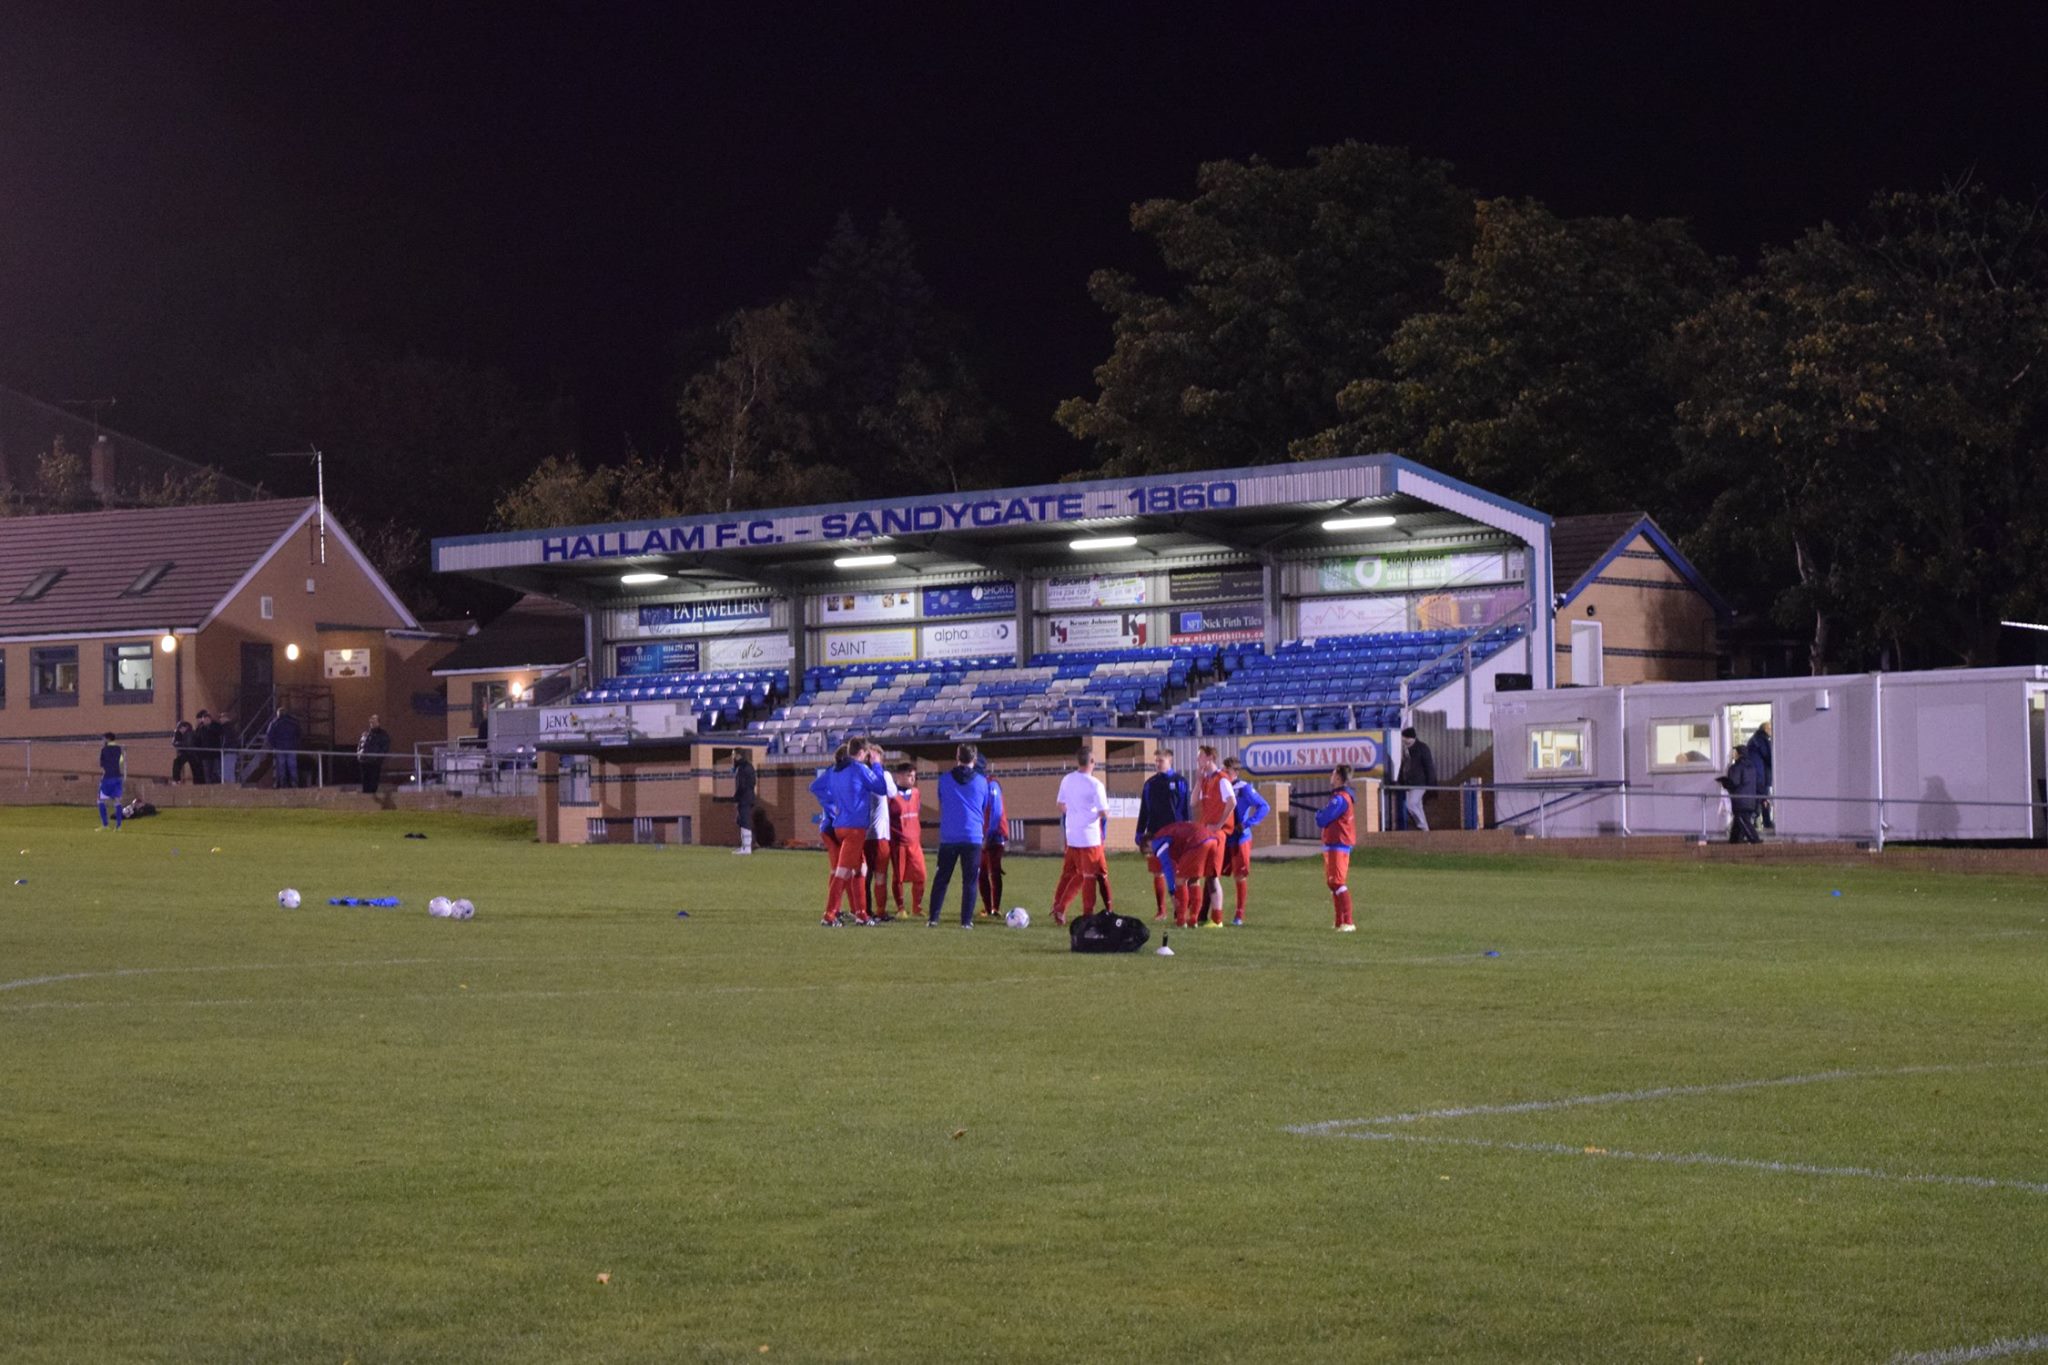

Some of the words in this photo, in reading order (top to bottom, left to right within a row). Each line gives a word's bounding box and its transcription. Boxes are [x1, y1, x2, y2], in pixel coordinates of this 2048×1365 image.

[542, 526, 705, 562] HALLAM
[716, 520, 784, 548] F.C.
[821, 493, 1084, 539] SANDYGATE
[1128, 482, 1237, 514] 1860
[691, 598, 766, 622] JEWELLERY
[1203, 618, 1220, 629] Nick
[1223, 617, 1241, 628] Firth
[1243, 615, 1262, 626] Tiles
[934, 628, 968, 643] alpha
[830, 640, 867, 657] SAINT
[545, 715, 569, 730] JENX
[1249, 746, 1373, 768] TOOLSTATION
